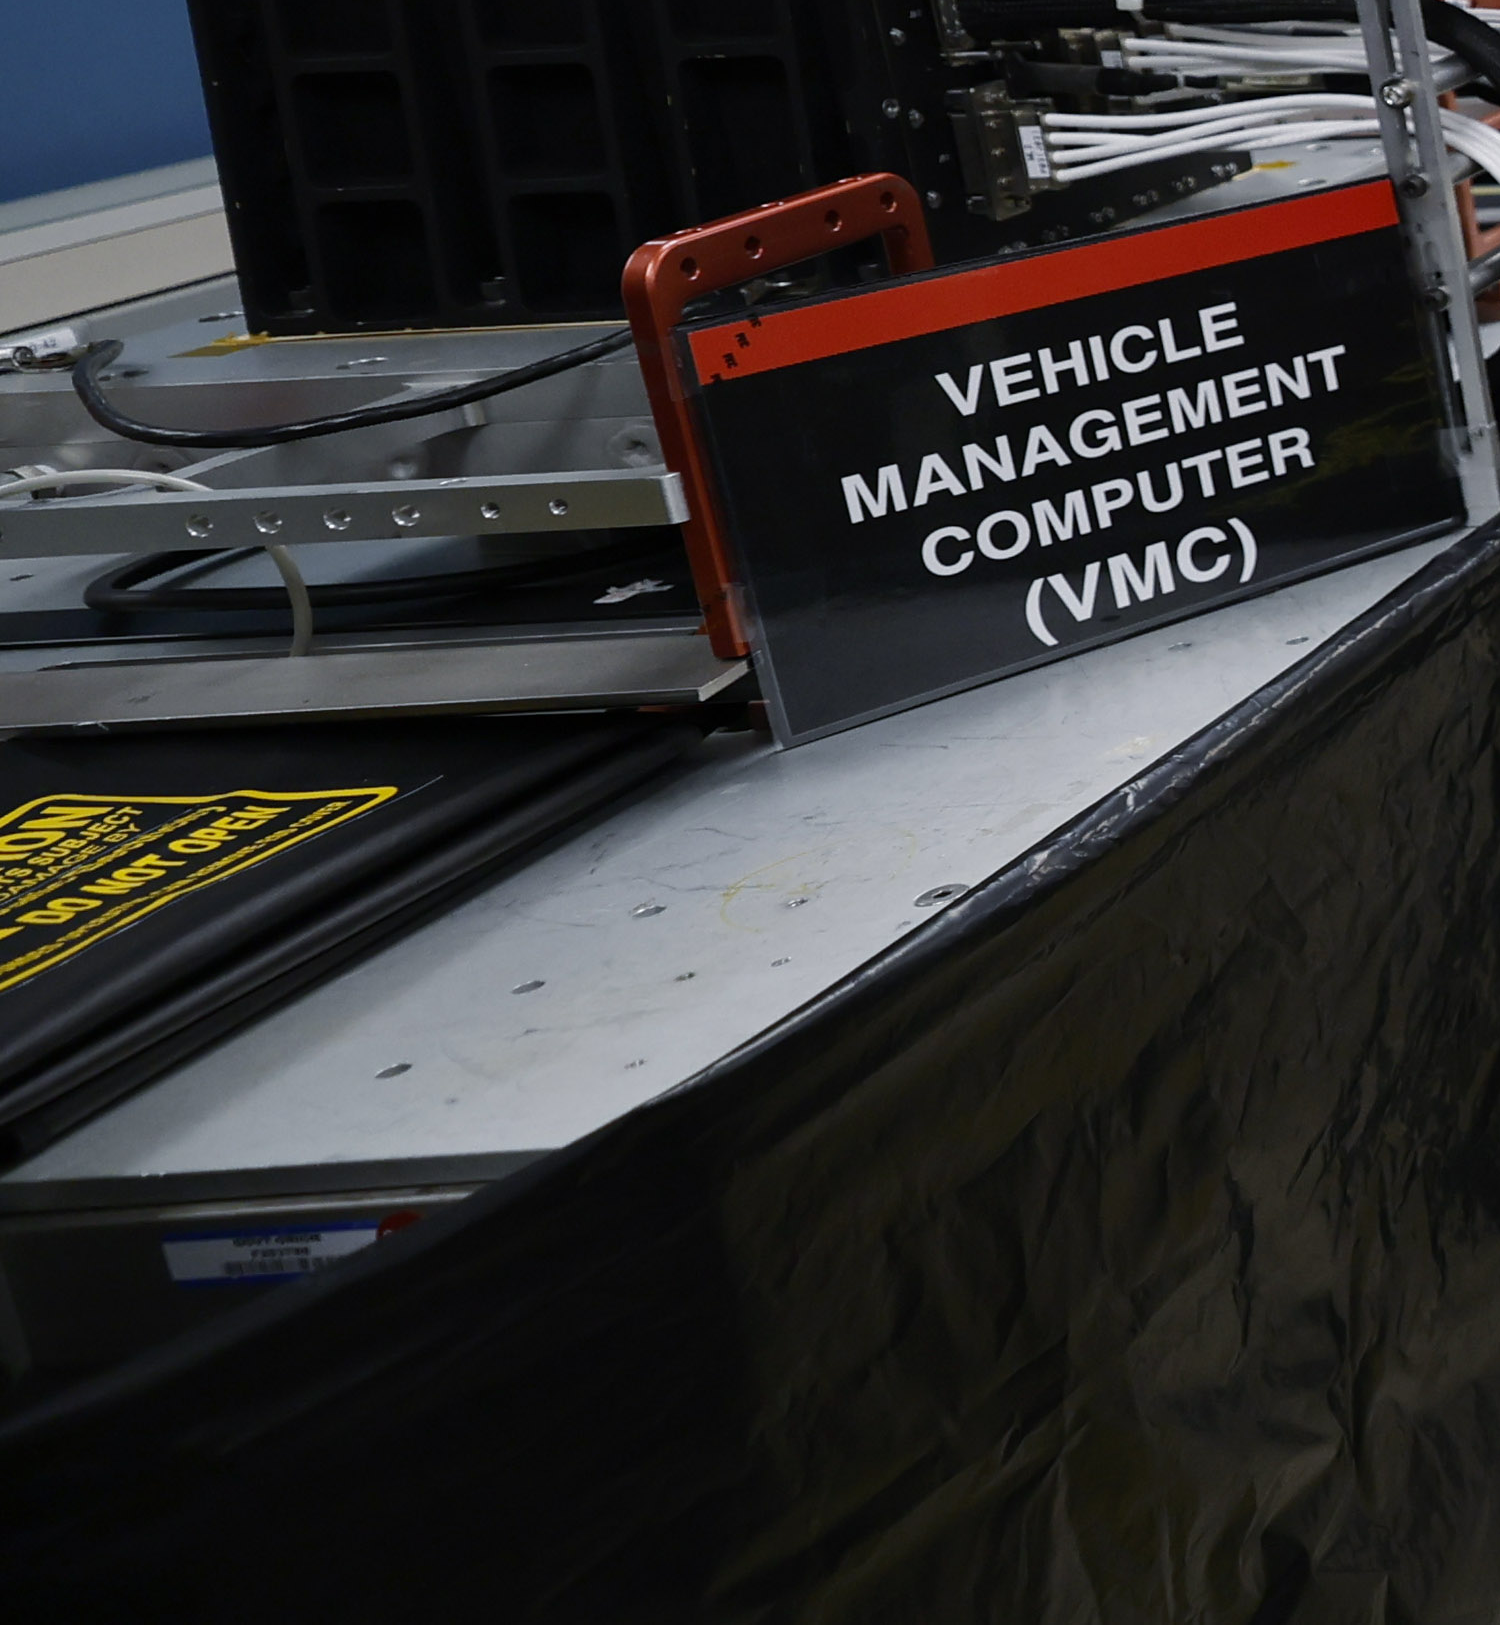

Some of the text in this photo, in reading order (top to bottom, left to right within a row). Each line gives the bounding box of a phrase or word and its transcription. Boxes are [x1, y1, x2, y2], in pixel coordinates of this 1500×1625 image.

[935, 302, 1245, 416] VEHICLE
[841, 345, 1346, 524] MANAGEMENT
[922, 427, 1315, 576] COMPUTER
[1025, 518, 1257, 646] (VMC)
[15, 897, 103, 924] DO
[80, 853, 187, 894] NOT
[168, 805, 292, 854] OPEN
[27, 806, 143, 866] SUBJECT
[102, 823, 141, 843] BY
